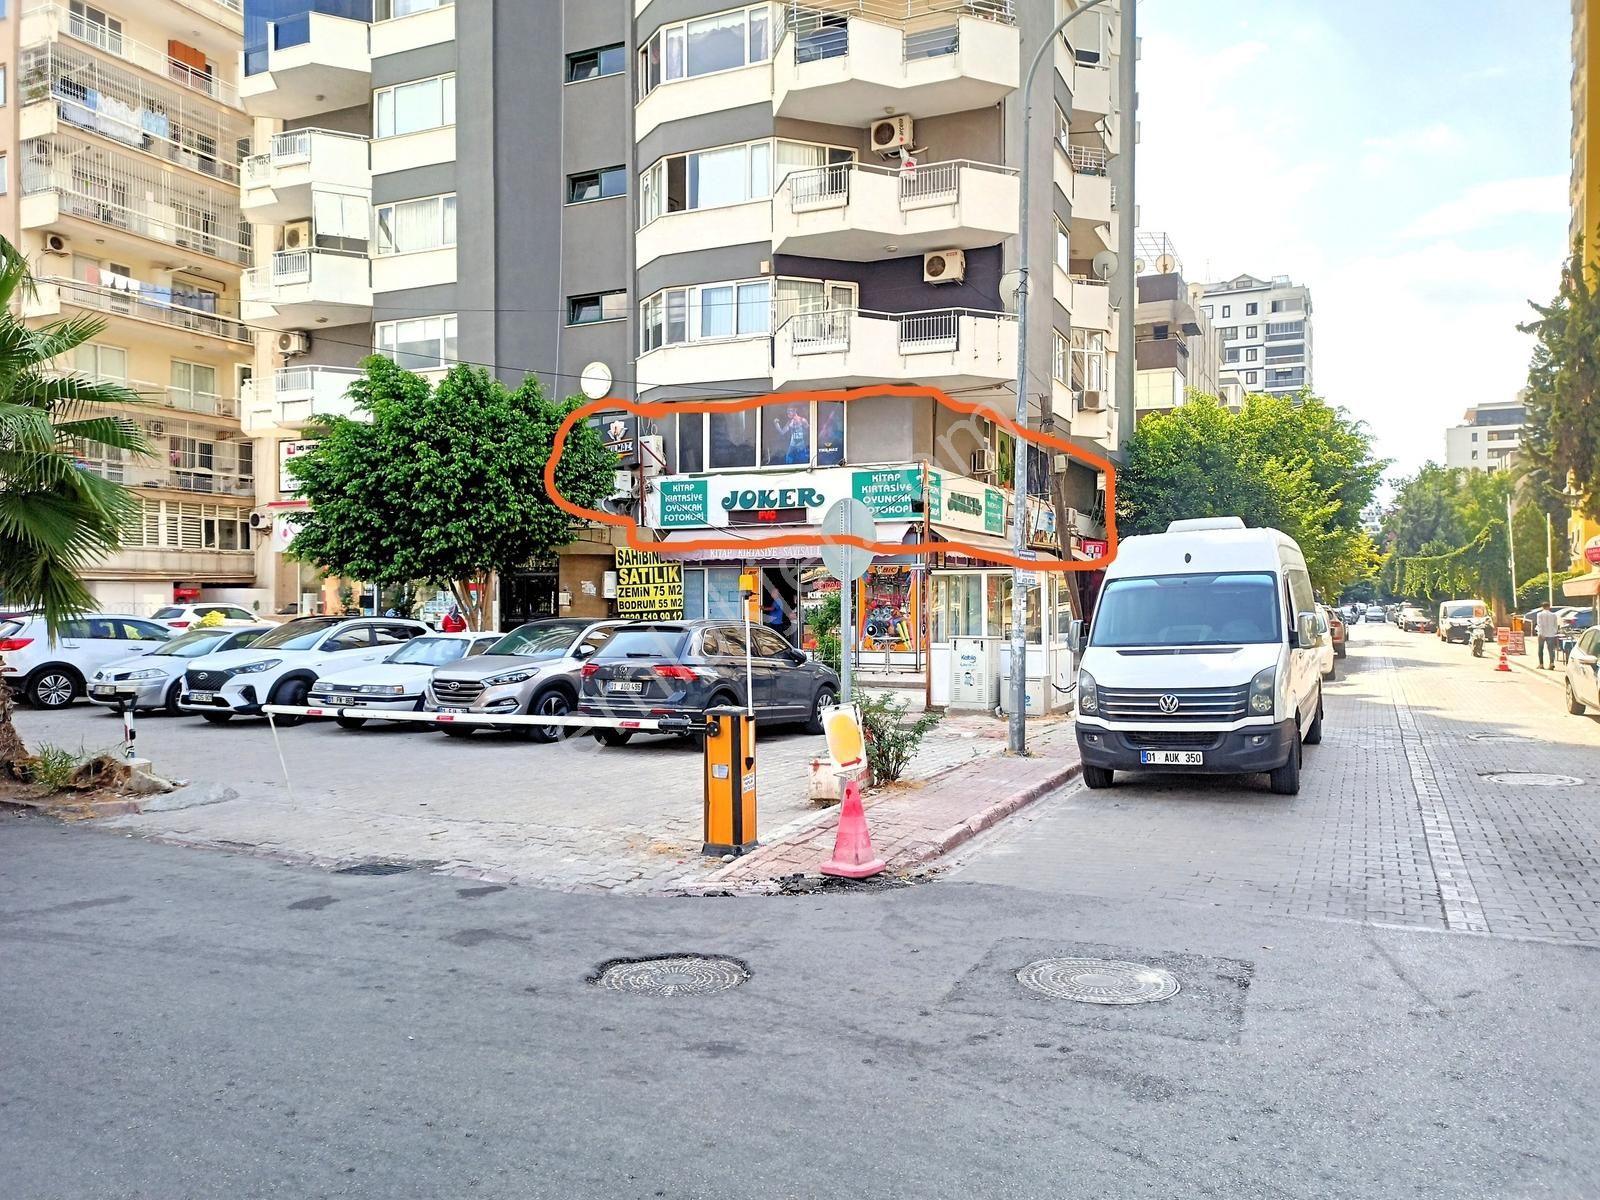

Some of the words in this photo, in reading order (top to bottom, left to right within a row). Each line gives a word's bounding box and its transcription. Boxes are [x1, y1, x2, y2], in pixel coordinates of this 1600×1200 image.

[872, 473, 901, 482] KİTAP
[672, 482, 695, 492] KİTAP
[861, 483, 913, 494] KIRTASİYE
[721, 488, 825, 510] JOKER
[862, 494, 912, 504] OYUNCAK
[665, 503, 703, 512] OYUNCAK
[867, 503, 913, 513] OTOKOPİ
[619, 566, 680, 585] SATILIK
[653, 585, 665, 596] 75
[668, 584, 682, 595] M2
[619, 600, 656, 610] BODRUM
[658, 599, 668, 608] 55
[670, 598, 683, 607] M2
[672, 611, 683, 621] 12
[1146, 752, 1156, 762] 01
[1164, 753, 1180, 763] AUK
[1185, 753, 1201, 763] 350
